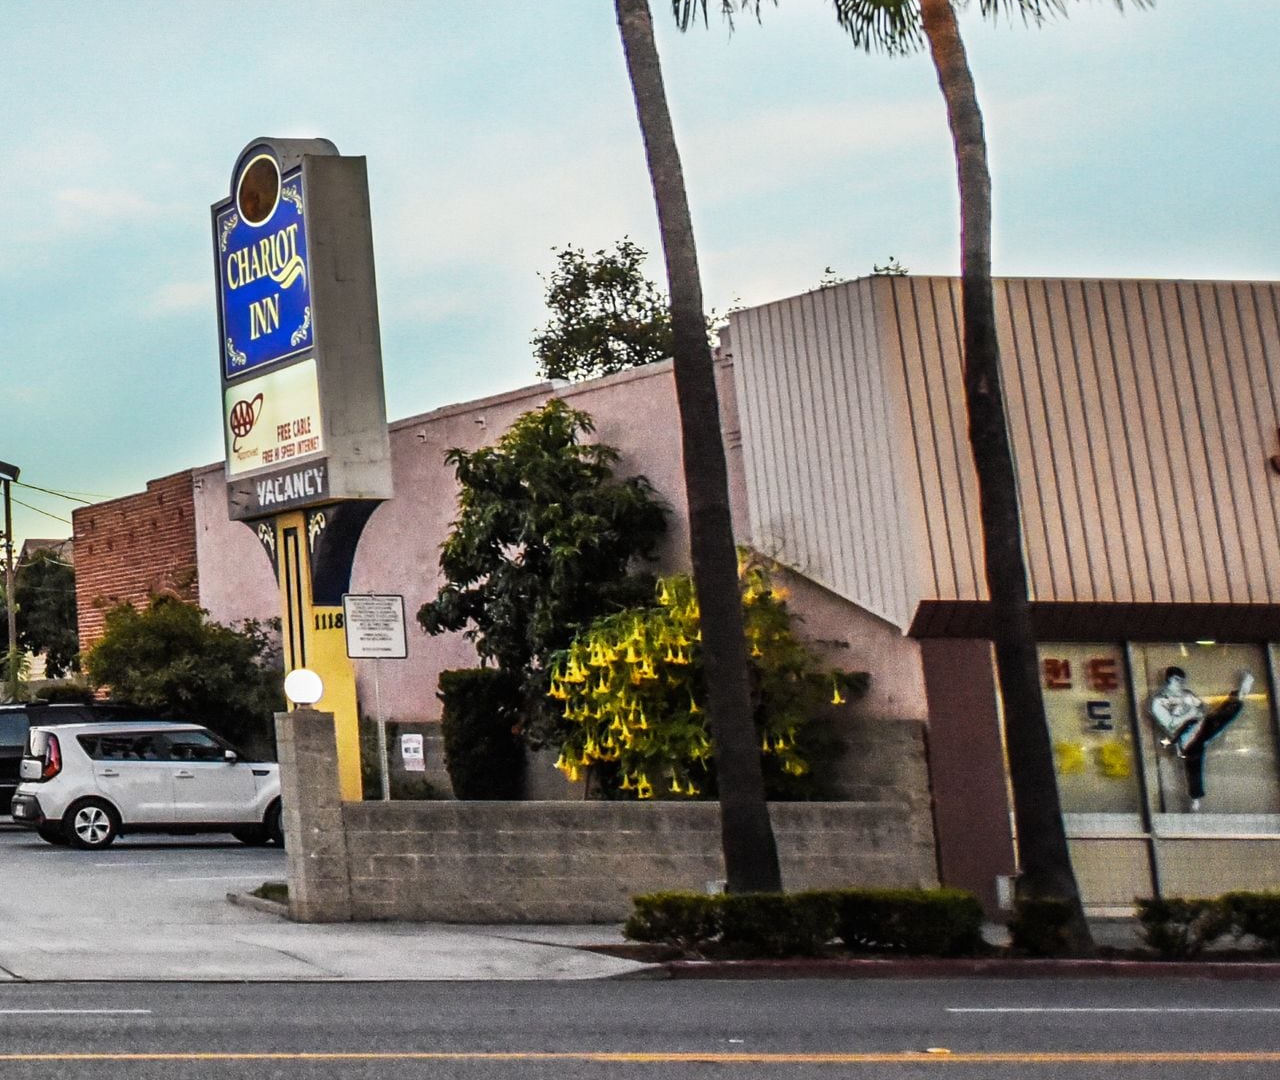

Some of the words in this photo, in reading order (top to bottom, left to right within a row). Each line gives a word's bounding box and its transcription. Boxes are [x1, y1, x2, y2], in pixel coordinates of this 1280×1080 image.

[227, 223, 306, 290] CHARIOT
[249, 293, 279, 340] INN
[230, 401, 254, 437] AAA
[277, 422, 291, 442] FREE
[293, 416, 311, 437] CABLE
[262, 449, 273, 464] FREE
[281, 443, 294, 459] SPEED
[297, 436, 319, 454] INTERNET
[257, 466, 324, 506] VACANCY
[315, 613, 344, 630] 1118
